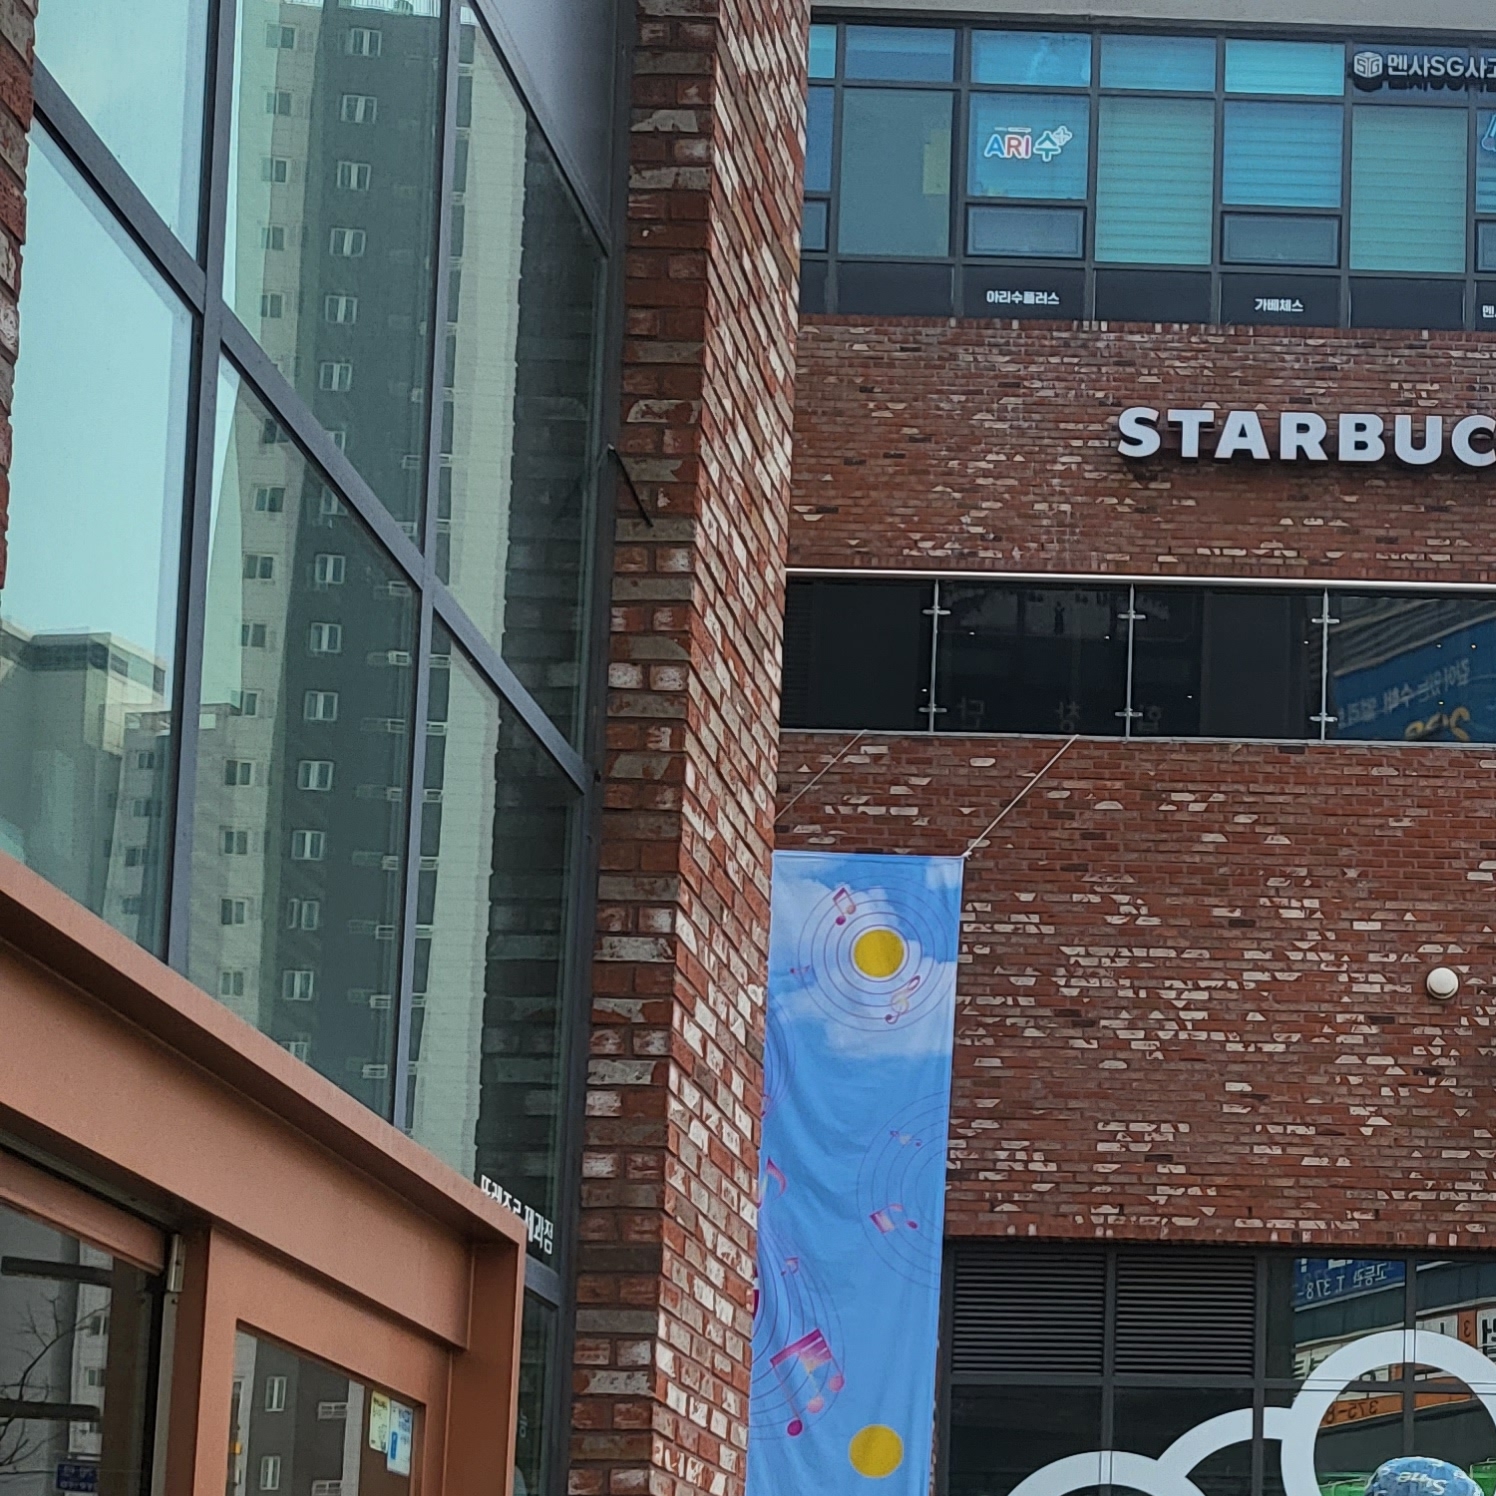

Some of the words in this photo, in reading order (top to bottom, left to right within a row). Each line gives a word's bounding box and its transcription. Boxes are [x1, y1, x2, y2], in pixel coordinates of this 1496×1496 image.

[986, 290, 1060, 305] 아리수플러스
[1254, 298, 1304, 313] 가베체스
[524, 1204, 555, 1255] 제과점
